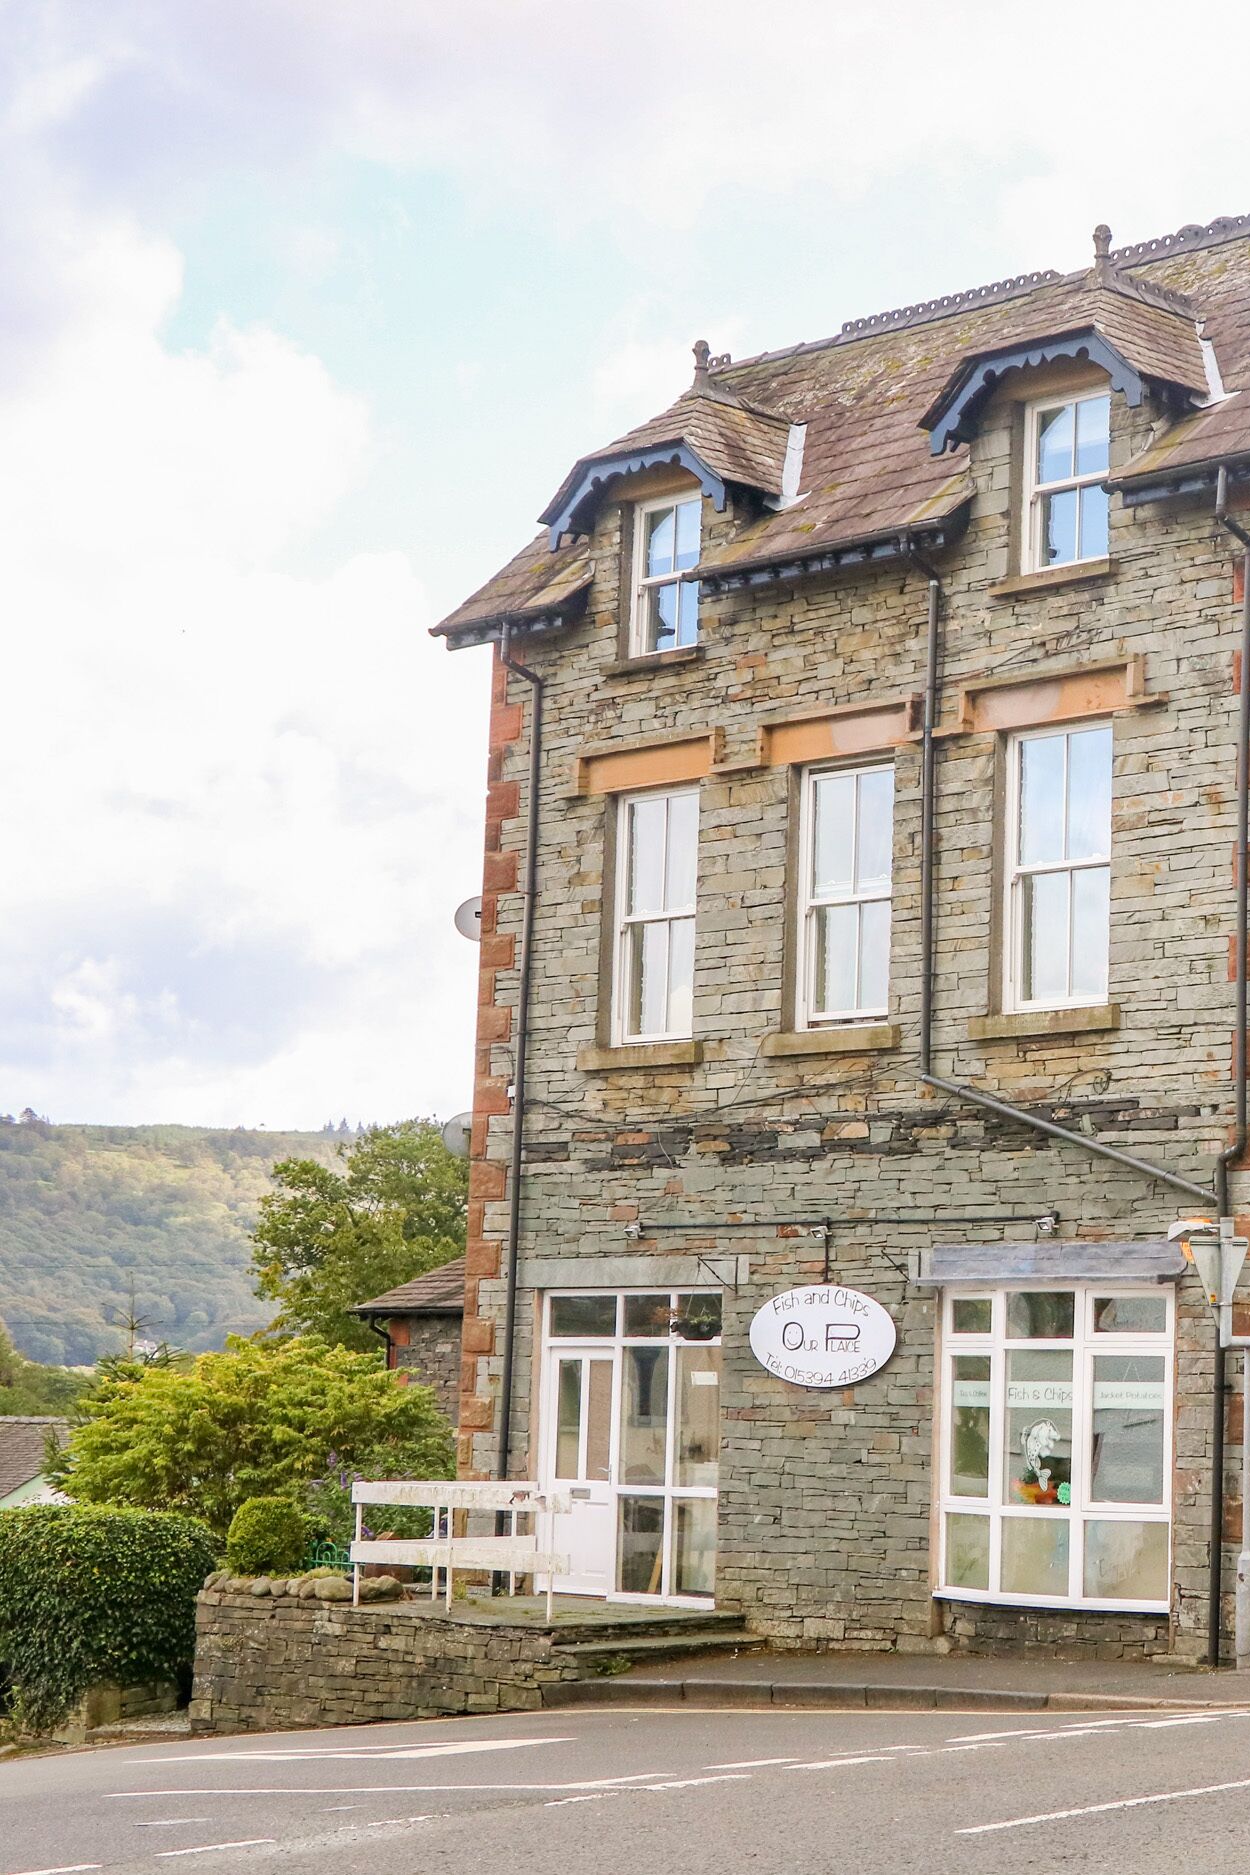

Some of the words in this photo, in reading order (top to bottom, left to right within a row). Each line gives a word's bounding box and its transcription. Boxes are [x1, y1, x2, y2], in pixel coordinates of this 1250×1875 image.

[772, 1292, 800, 1315] Fish
[804, 1289, 830, 1305] and
[834, 1289, 871, 1317] Chips
[766, 1352, 783, 1375] Tel:
[784, 1365, 833, 1385] 015394
[838, 1358, 877, 1383] 41339
[1008, 1387, 1030, 1401] Fish
[1032, 1388, 1041, 1400] &
[1044, 1387, 1073, 1404] Chips
[1098, 1391, 1126, 1400] Jacket
[1127, 1391, 1163, 1400] Potatoes
